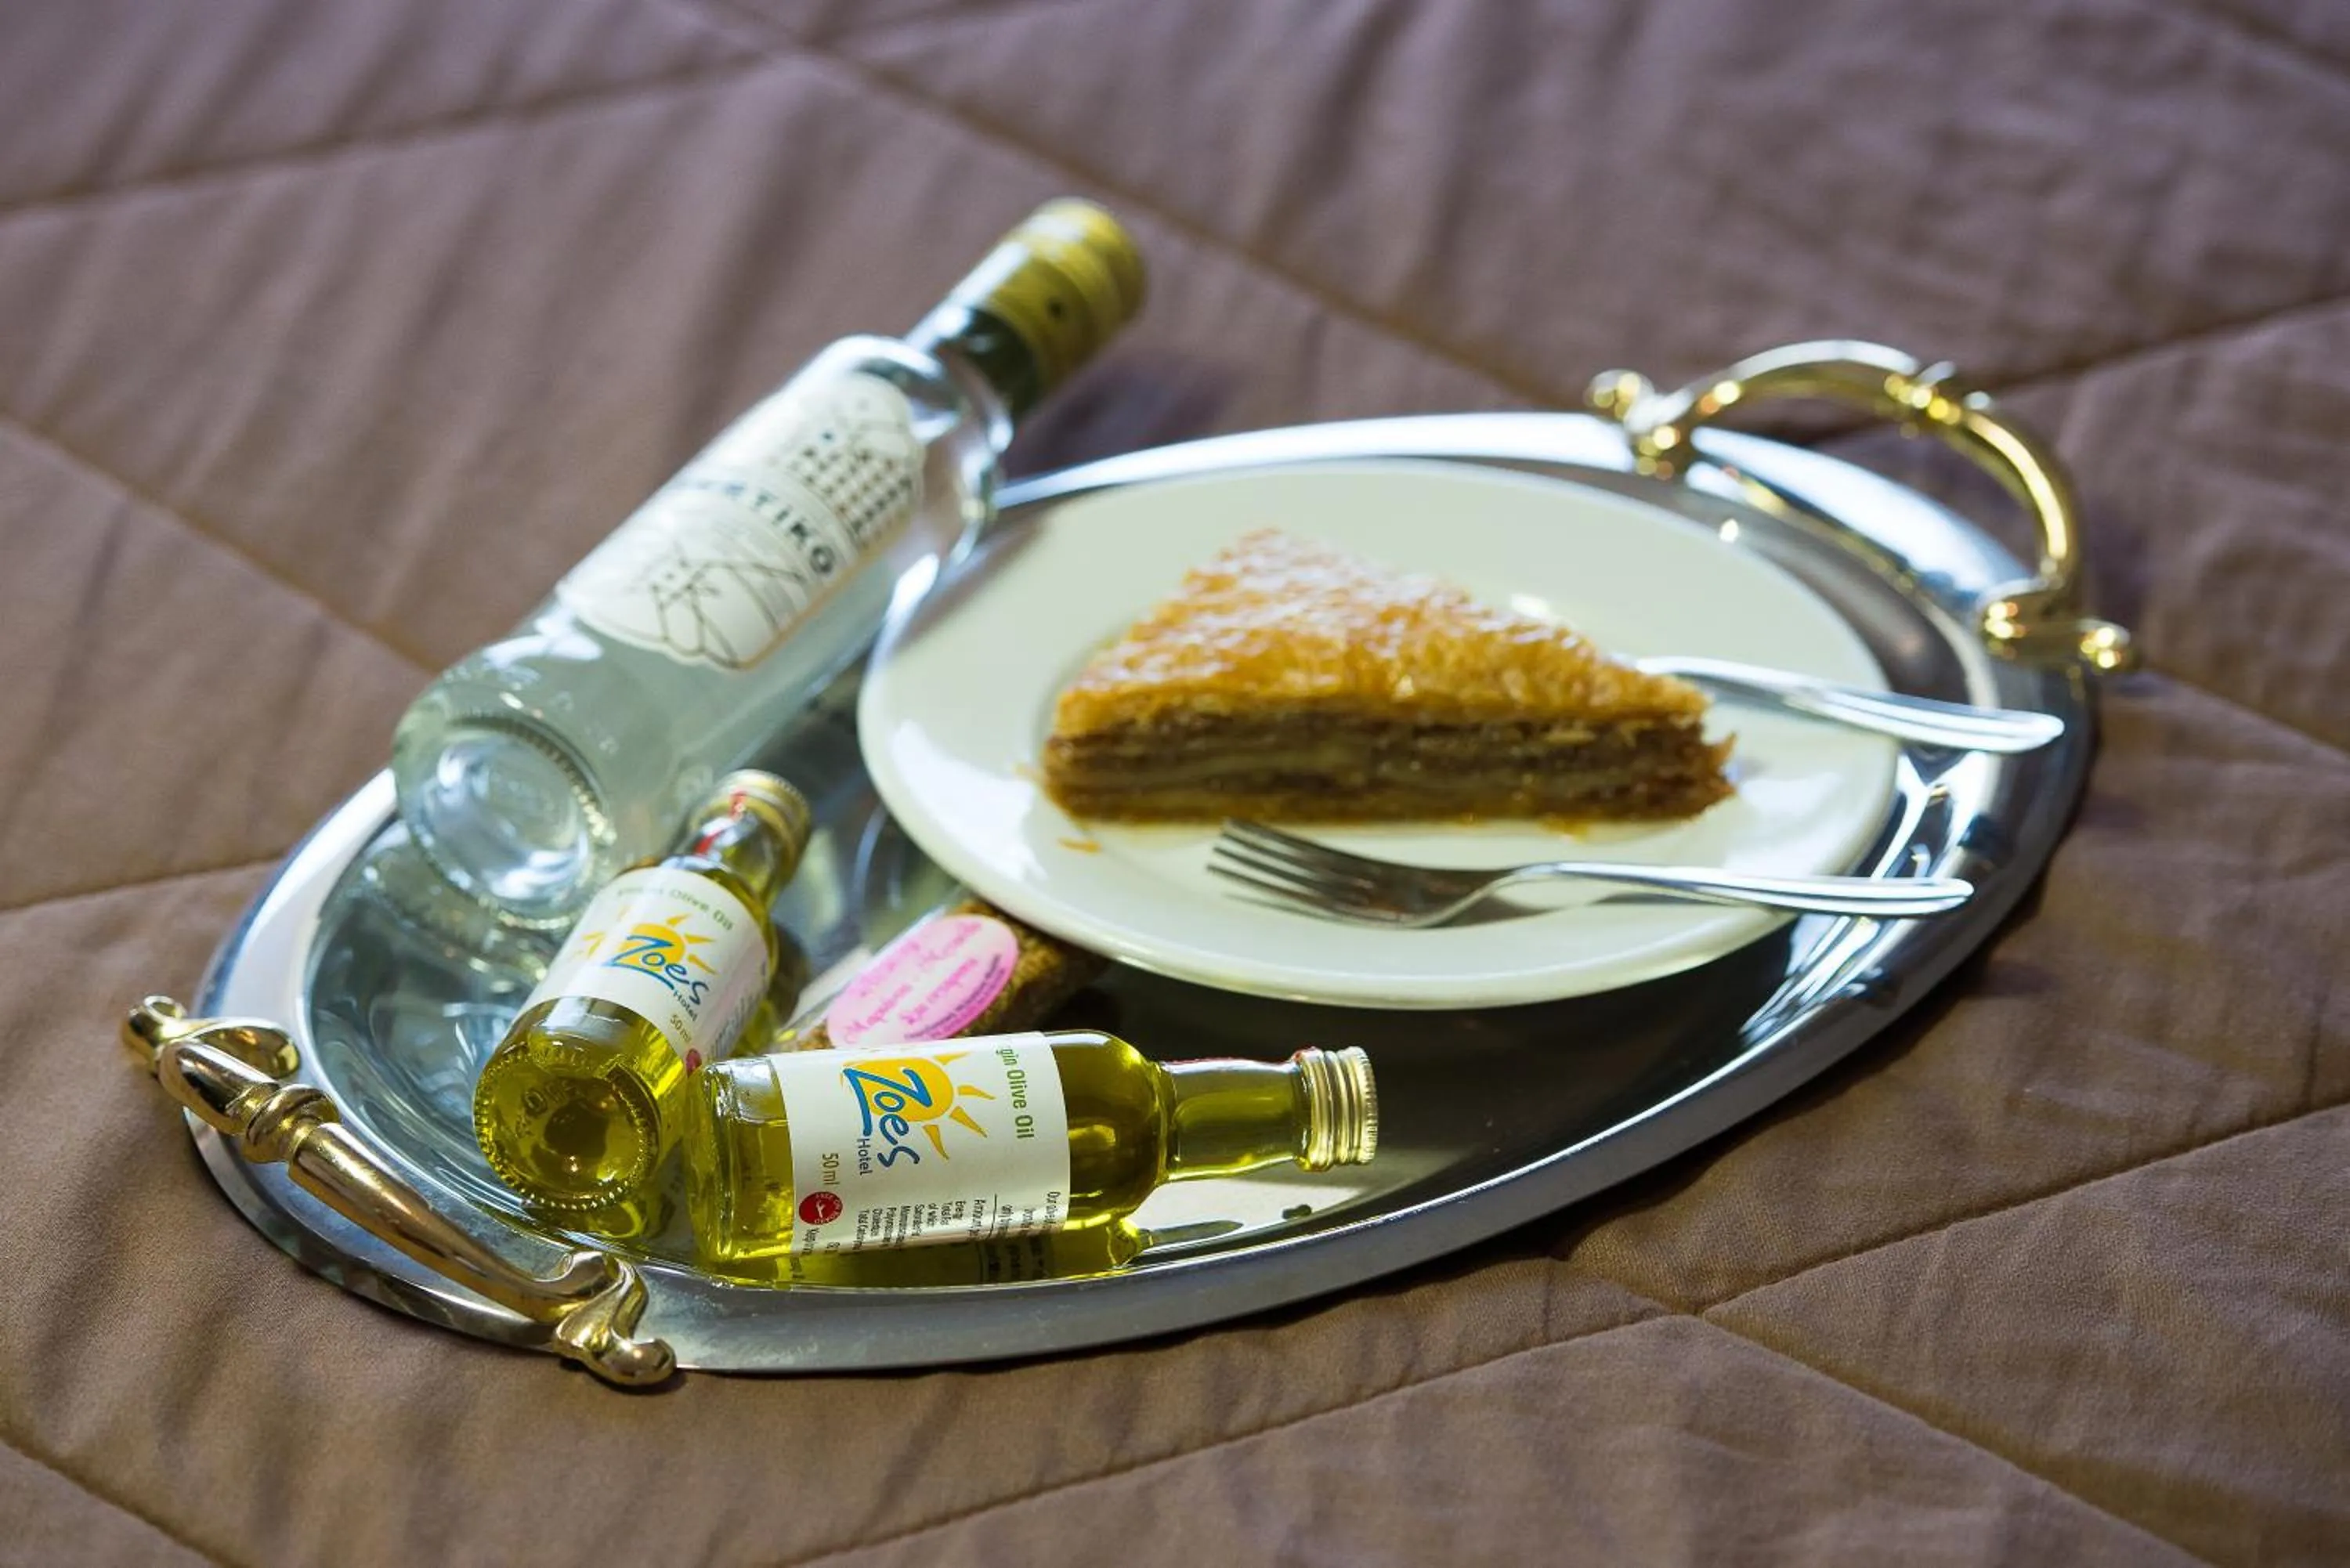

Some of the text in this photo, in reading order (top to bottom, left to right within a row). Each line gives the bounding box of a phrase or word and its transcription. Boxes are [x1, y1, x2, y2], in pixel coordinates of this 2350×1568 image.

[602, 934, 710, 1006] Zoes
[672, 990, 699, 1022] Hotel
[1007, 1069, 1030, 1110] Olive
[841, 1066, 934, 1168] Zoes
[1014, 1115, 1035, 1140] Oil
[858, 1137, 873, 1176] Hotel
